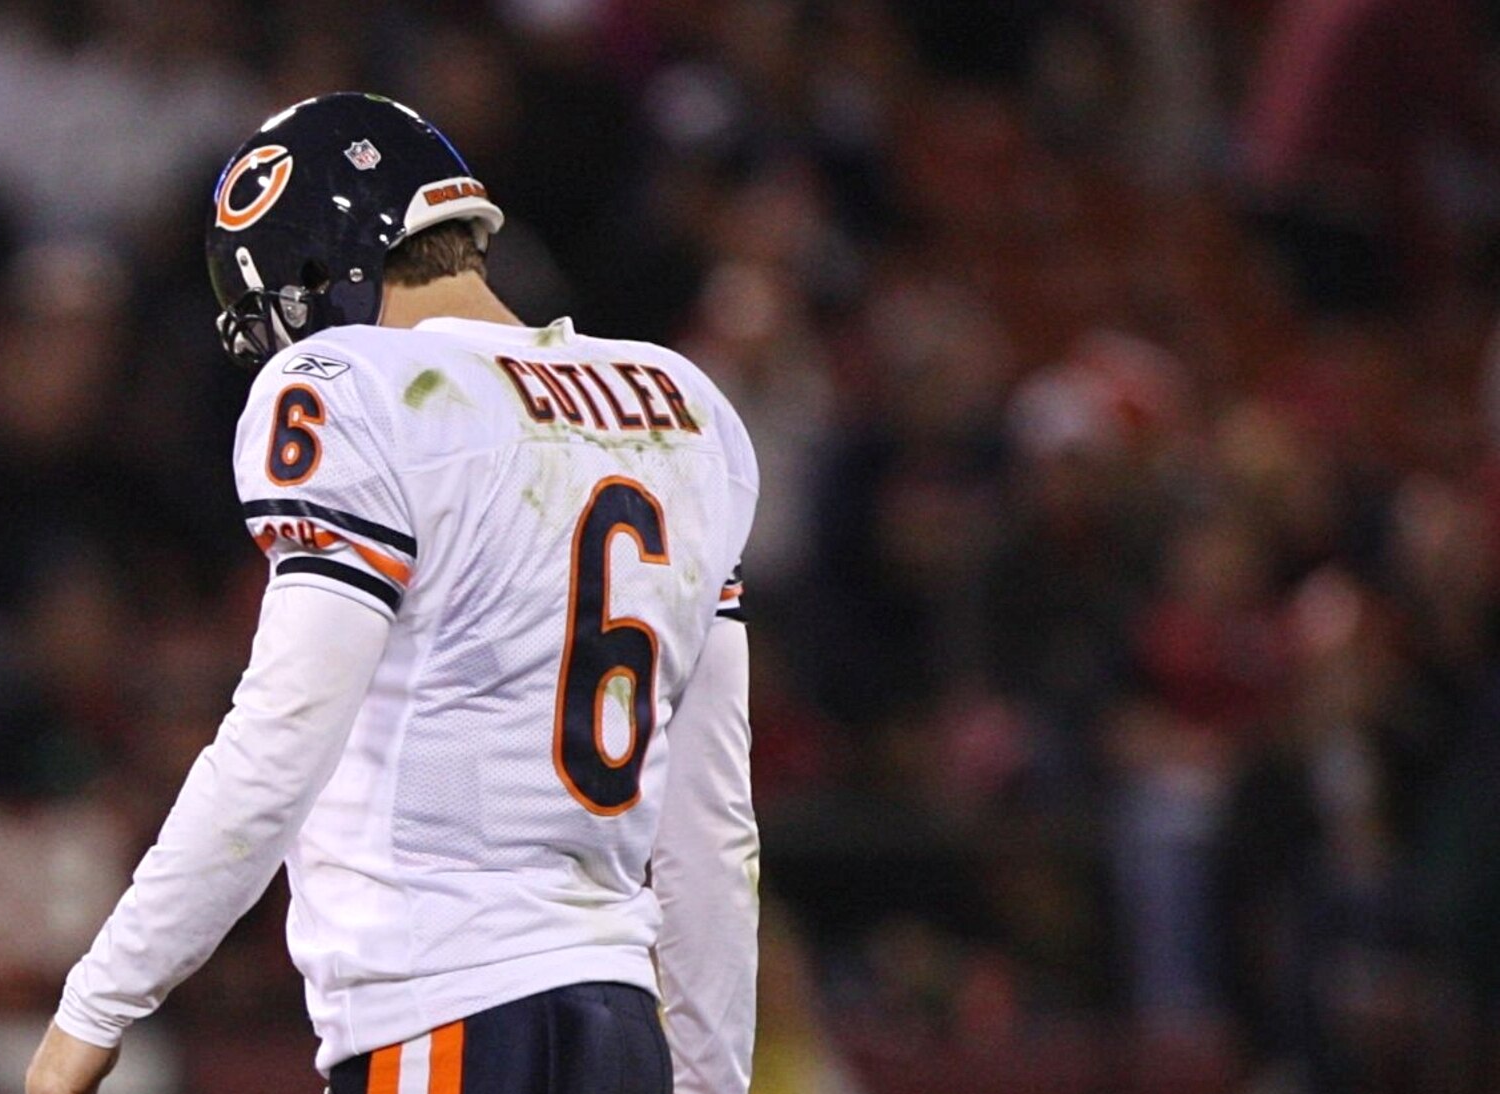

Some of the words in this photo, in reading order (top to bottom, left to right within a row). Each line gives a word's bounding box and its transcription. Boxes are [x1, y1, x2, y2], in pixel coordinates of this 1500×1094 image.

[266, 383, 326, 486] 6
[495, 355, 702, 435] CUTLER
[552, 475, 670, 817] 6
